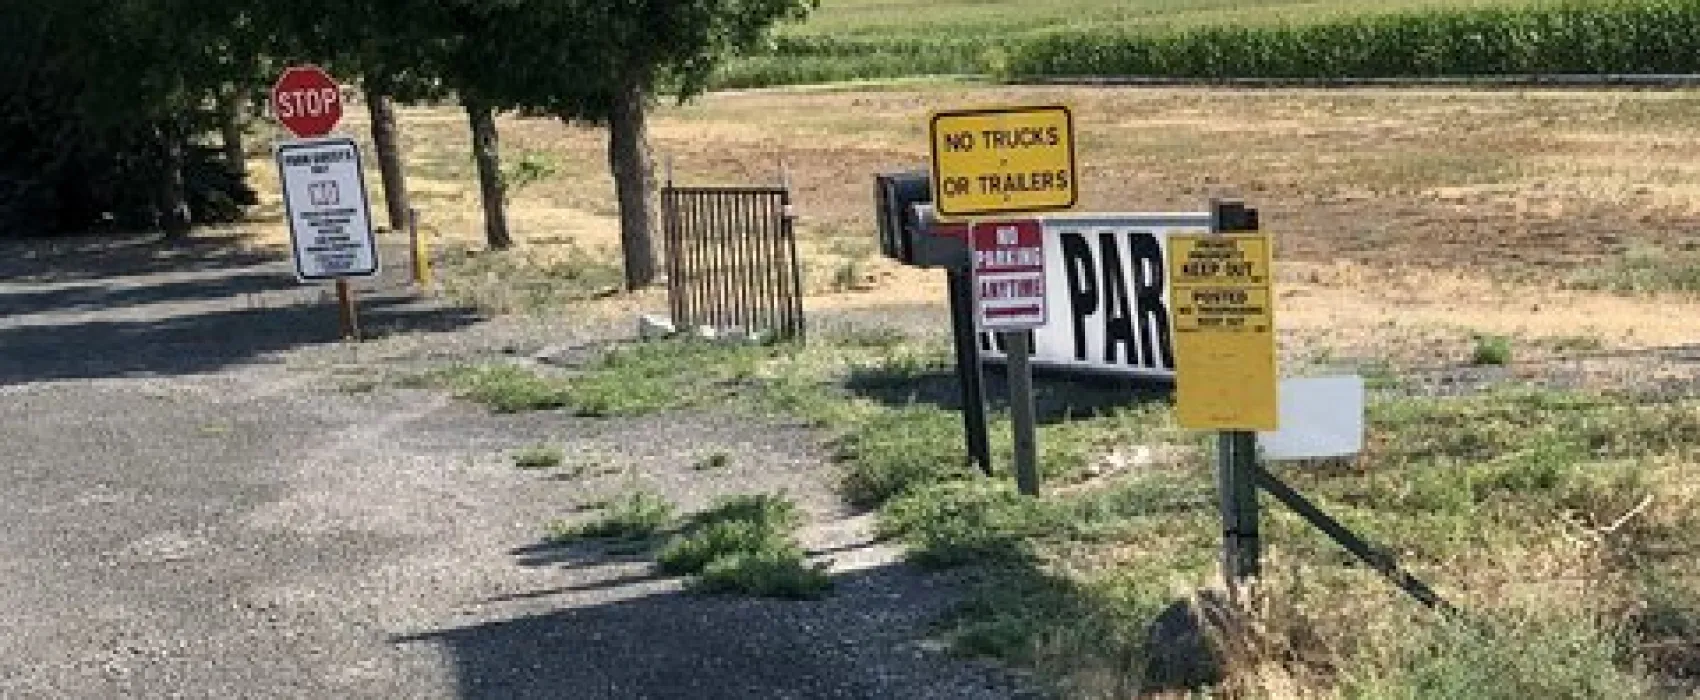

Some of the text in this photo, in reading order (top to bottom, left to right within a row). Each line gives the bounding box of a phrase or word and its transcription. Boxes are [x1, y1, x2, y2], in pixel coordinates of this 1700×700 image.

[279, 88, 336, 117] STOP
[944, 127, 1060, 152] NO TRUCKS
[944, 170, 1068, 198] OR TRAILERS
[997, 226, 1018, 244] NO
[975, 247, 1040, 269] PARKING
[1182, 261, 1253, 277] KEEP OUT
[981, 279, 1041, 299] ANYTIME
[1059, 232, 1174, 368] PAR
